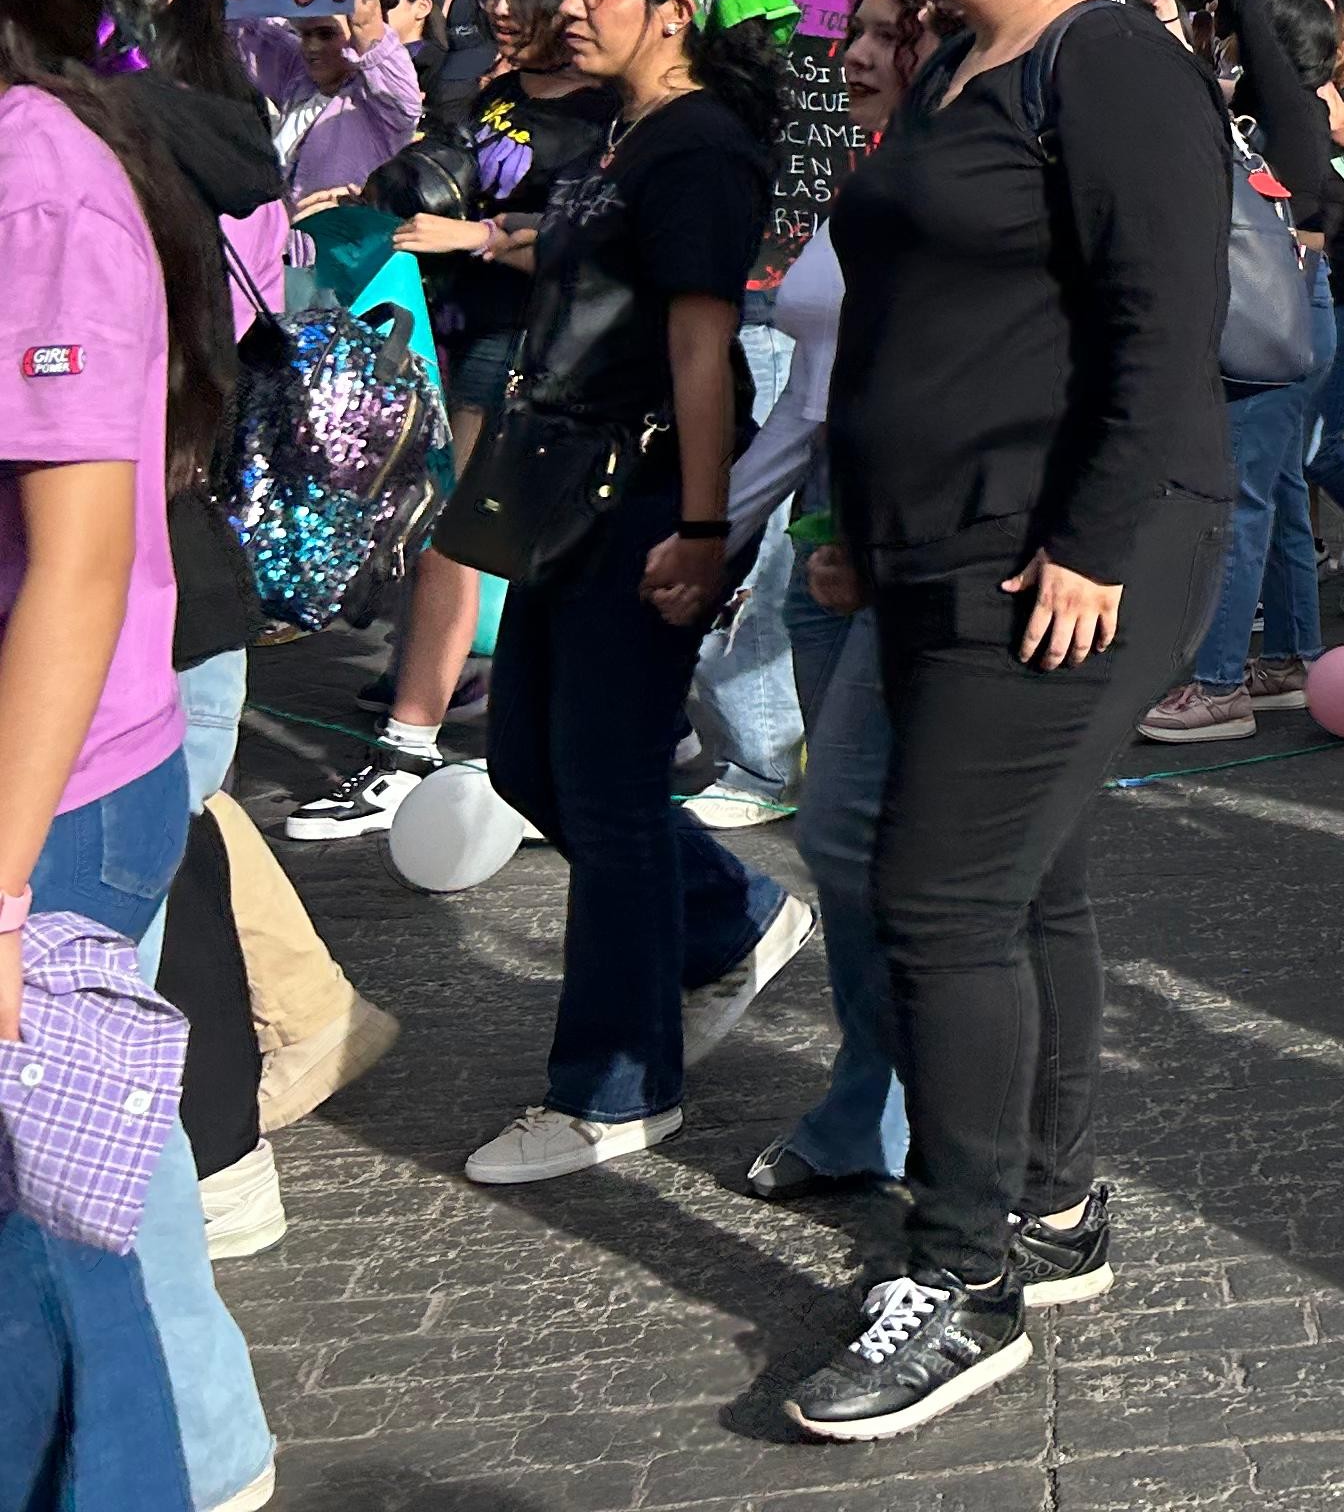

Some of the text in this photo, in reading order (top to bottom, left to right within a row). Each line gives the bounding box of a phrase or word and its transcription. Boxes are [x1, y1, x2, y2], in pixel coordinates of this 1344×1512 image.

[788, 90, 850, 114] NCUE
[790, 152, 833, 176] EN
[774, 180, 832, 202] LAS
[773, 206, 819, 237] RE
[33, 347, 70, 364] GIRL
[34, 361, 71, 374] POWER
